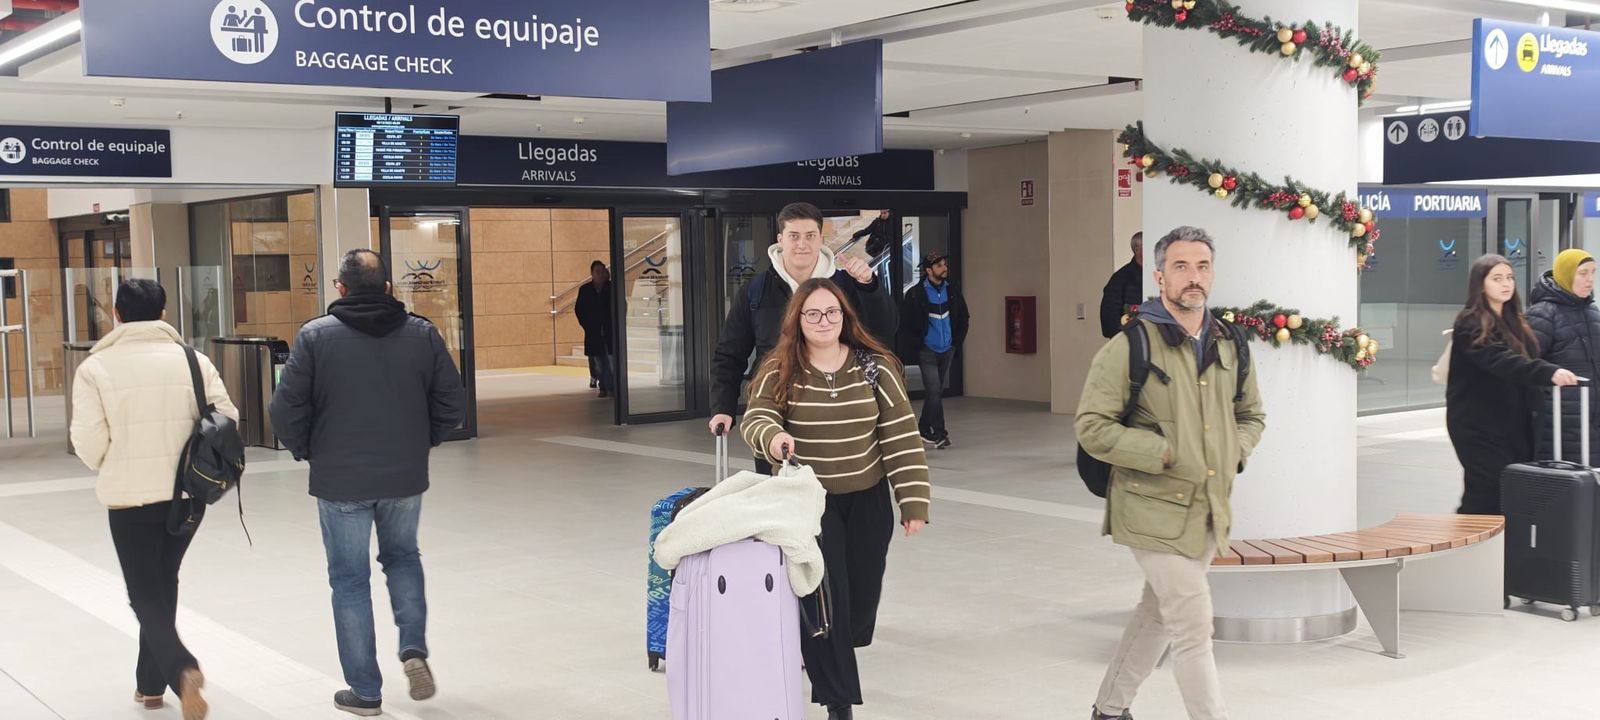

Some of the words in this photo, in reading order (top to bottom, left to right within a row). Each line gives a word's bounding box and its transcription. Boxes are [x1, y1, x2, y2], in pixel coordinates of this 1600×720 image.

[294, 0, 416, 34] Control
[427, 7, 465, 37] de
[475, 15, 599, 52] equipaje
[1540, 33, 1588, 58] Llegadas
[295, 50, 389, 71] BAGGAGE
[394, 56, 453, 75] CHECK
[31, 138, 83, 151] Control
[87, 139, 105, 151] de
[108, 140, 166, 155] equipaje
[518, 142, 598, 164] Llegadas
[31, 157, 72, 165] BAGGAGE
[73, 158, 100, 166] CHECK
[796, 155, 860, 171] egadas
[521, 169, 577, 182] ARRIVALS
[818, 175, 863, 186] ARRIVALS
[1359, 190, 1392, 211] LICÍA
[1414, 194, 1482, 212] PORTUARIA
